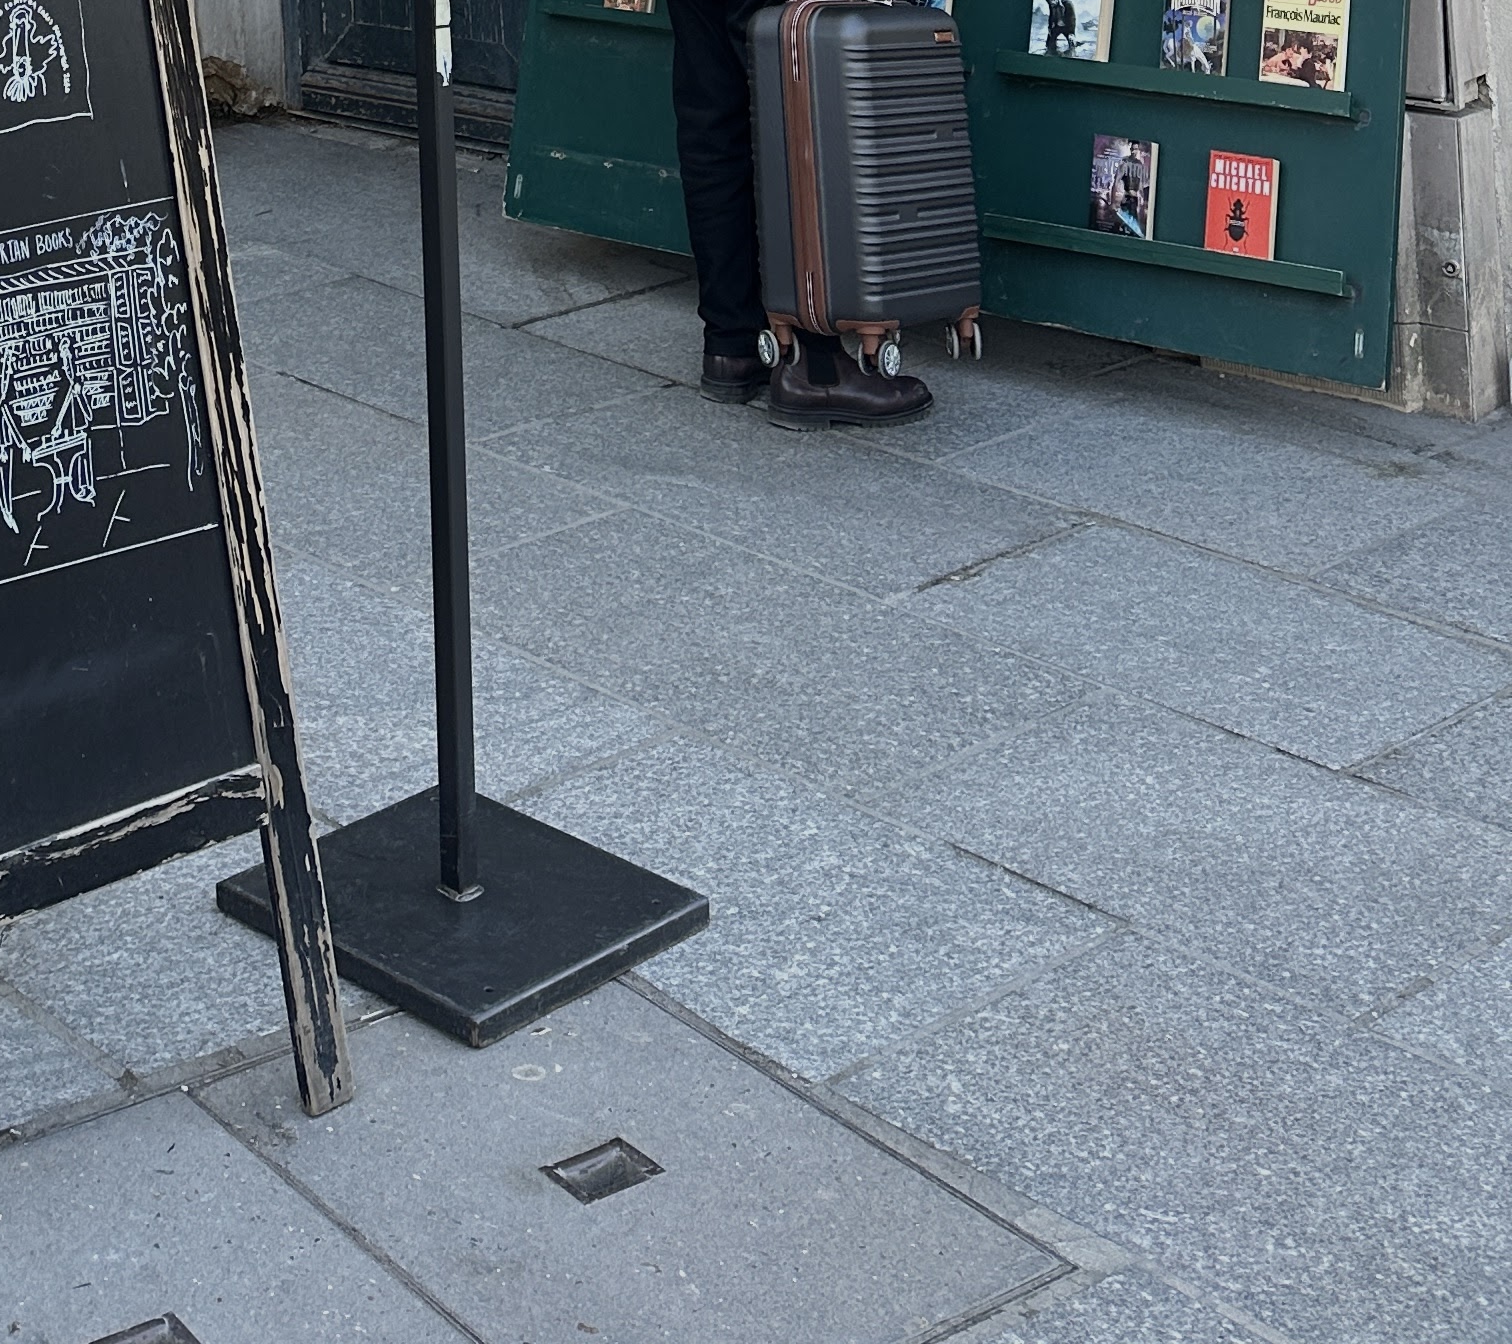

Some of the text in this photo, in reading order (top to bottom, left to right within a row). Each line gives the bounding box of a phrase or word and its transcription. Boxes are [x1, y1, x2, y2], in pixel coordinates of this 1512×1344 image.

[1266, 4, 1342, 26] François Mauriac
[1214, 158, 1269, 181] MICHAEL
[1210, 172, 1271, 196] CRICHTON
[35, 228, 73, 255] BOOKS
